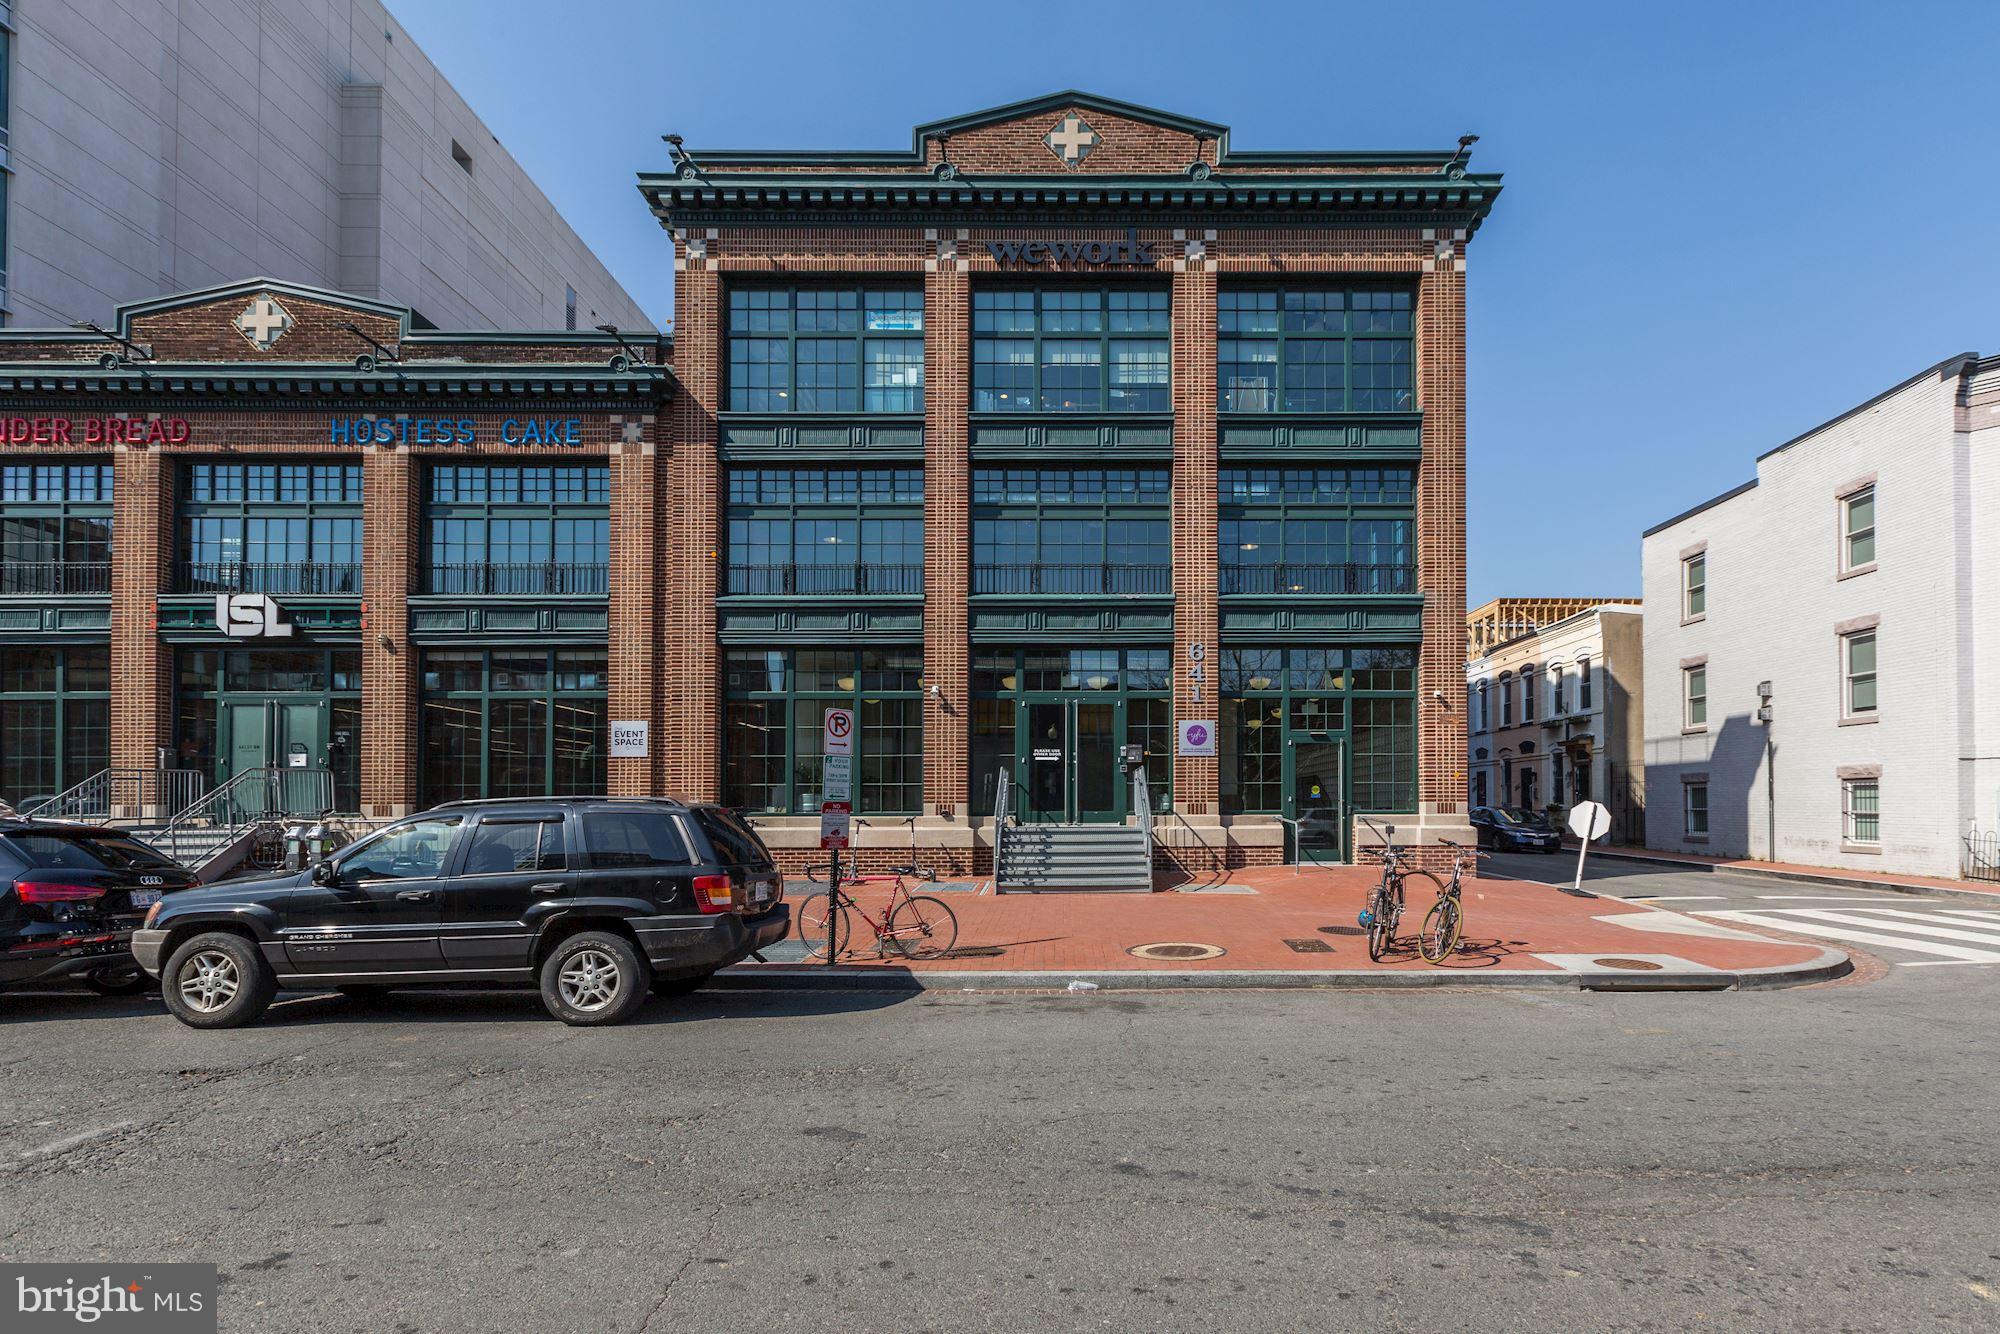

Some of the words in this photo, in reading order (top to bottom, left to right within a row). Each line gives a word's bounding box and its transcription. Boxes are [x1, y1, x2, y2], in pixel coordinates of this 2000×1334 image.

[985, 227, 1157, 266] wework
[85, 418, 191, 444] BREAD
[331, 418, 477, 445] HOSTESS
[501, 418, 582, 446] CAKE
[216, 594, 292, 637] ISL
[614, 730, 645, 738] EVENT
[614, 738, 644, 746] SPACE
